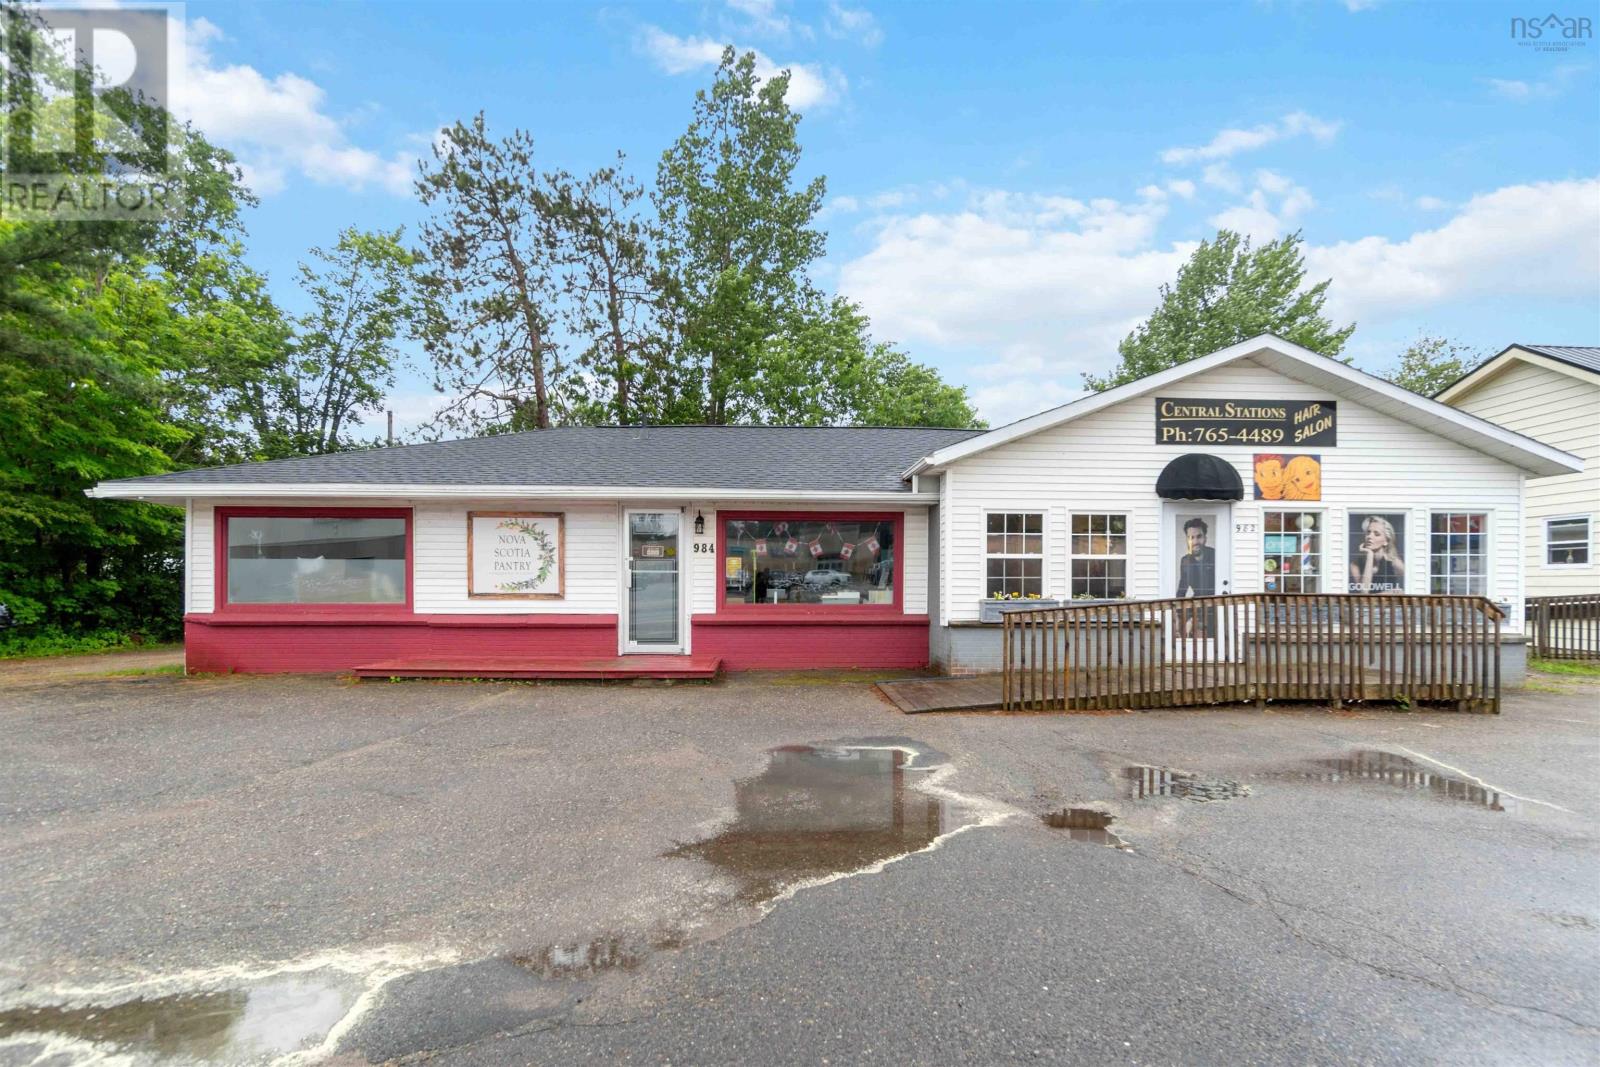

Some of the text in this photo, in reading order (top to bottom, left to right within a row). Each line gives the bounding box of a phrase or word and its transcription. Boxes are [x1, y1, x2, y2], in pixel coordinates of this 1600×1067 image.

[1161, 401, 1287, 419] CENTRAL STATIONS
[1294, 403, 1321, 425] HAIR
[1161, 427, 1285, 443] Ph:765-4489
[1294, 415, 1332, 443] SALON
[498, 535, 526, 545] NOVA
[494, 548, 531, 558] SCOTIA
[693, 543, 715, 553] 984
[494, 561, 531, 571] PANTRY
